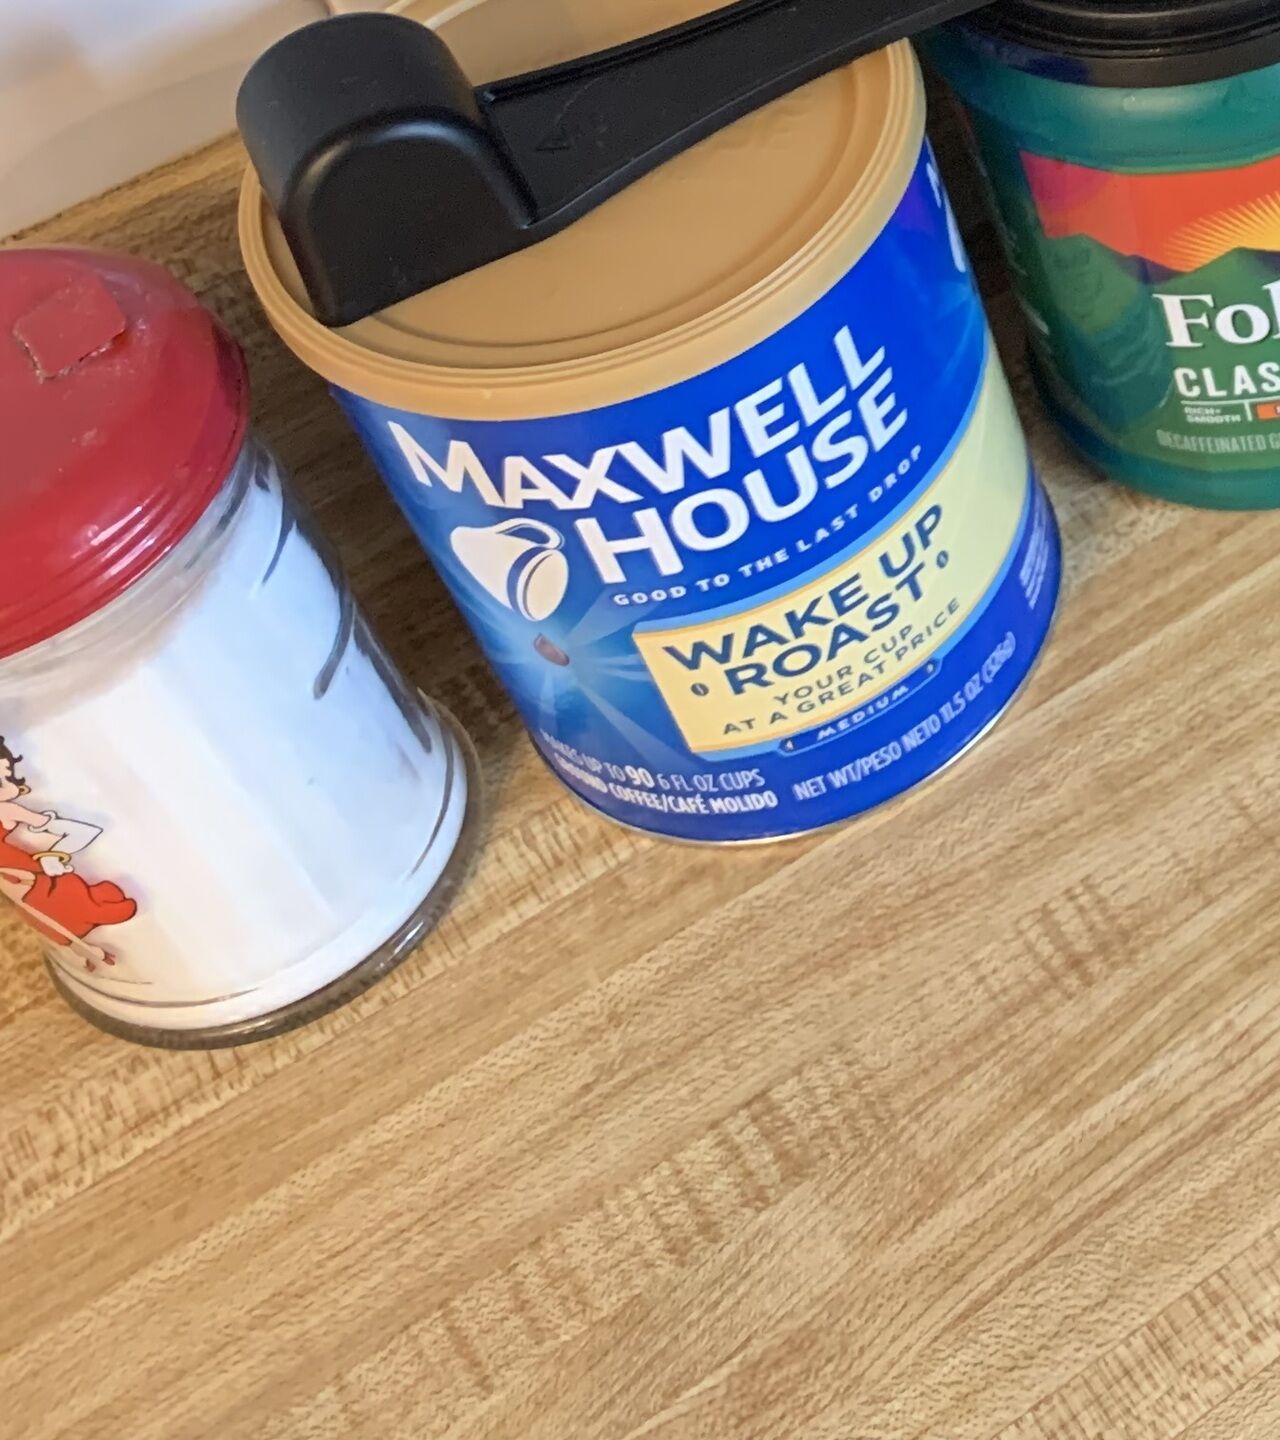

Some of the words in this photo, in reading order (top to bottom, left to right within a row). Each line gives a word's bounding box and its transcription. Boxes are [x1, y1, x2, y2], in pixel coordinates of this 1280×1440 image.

[387, 325, 885, 510] MAXWELL
[575, 366, 908, 584] HOUSE
[1156, 429, 1267, 454] DECAFFEINATED
[613, 585, 687, 606] GOOD
[695, 573, 730, 592] TO
[738, 547, 790, 578] THE
[796, 503, 859, 553] LAST
[868, 444, 922, 503] DROP
[662, 572, 869, 671] WAKE
[879, 504, 943, 578] UP
[723, 718, 756, 735] AT
[769, 711, 789, 726] A
[796, 660, 887, 713] GREAT
[897, 597, 960, 662] PRICE
[724, 561, 926, 695] ROAST
[773, 665, 854, 706] YOUR
[863, 624, 914, 664] CUP
[602, 761, 626, 782] TO
[624, 765, 655, 788] 90
[656, 773, 671, 790] 6
[672, 774, 693, 792] FL
[693, 774, 718, 792] OZ
[718, 768, 766, 791] CUPS
[792, 775, 828, 801] NET
[827, 741, 901, 789] WT/PESO
[901, 713, 942, 752] NETO
[964, 672, 984, 701] OZ
[816, 684, 909, 741] MEDIUM
[710, 791, 778, 815] MOLIDO
